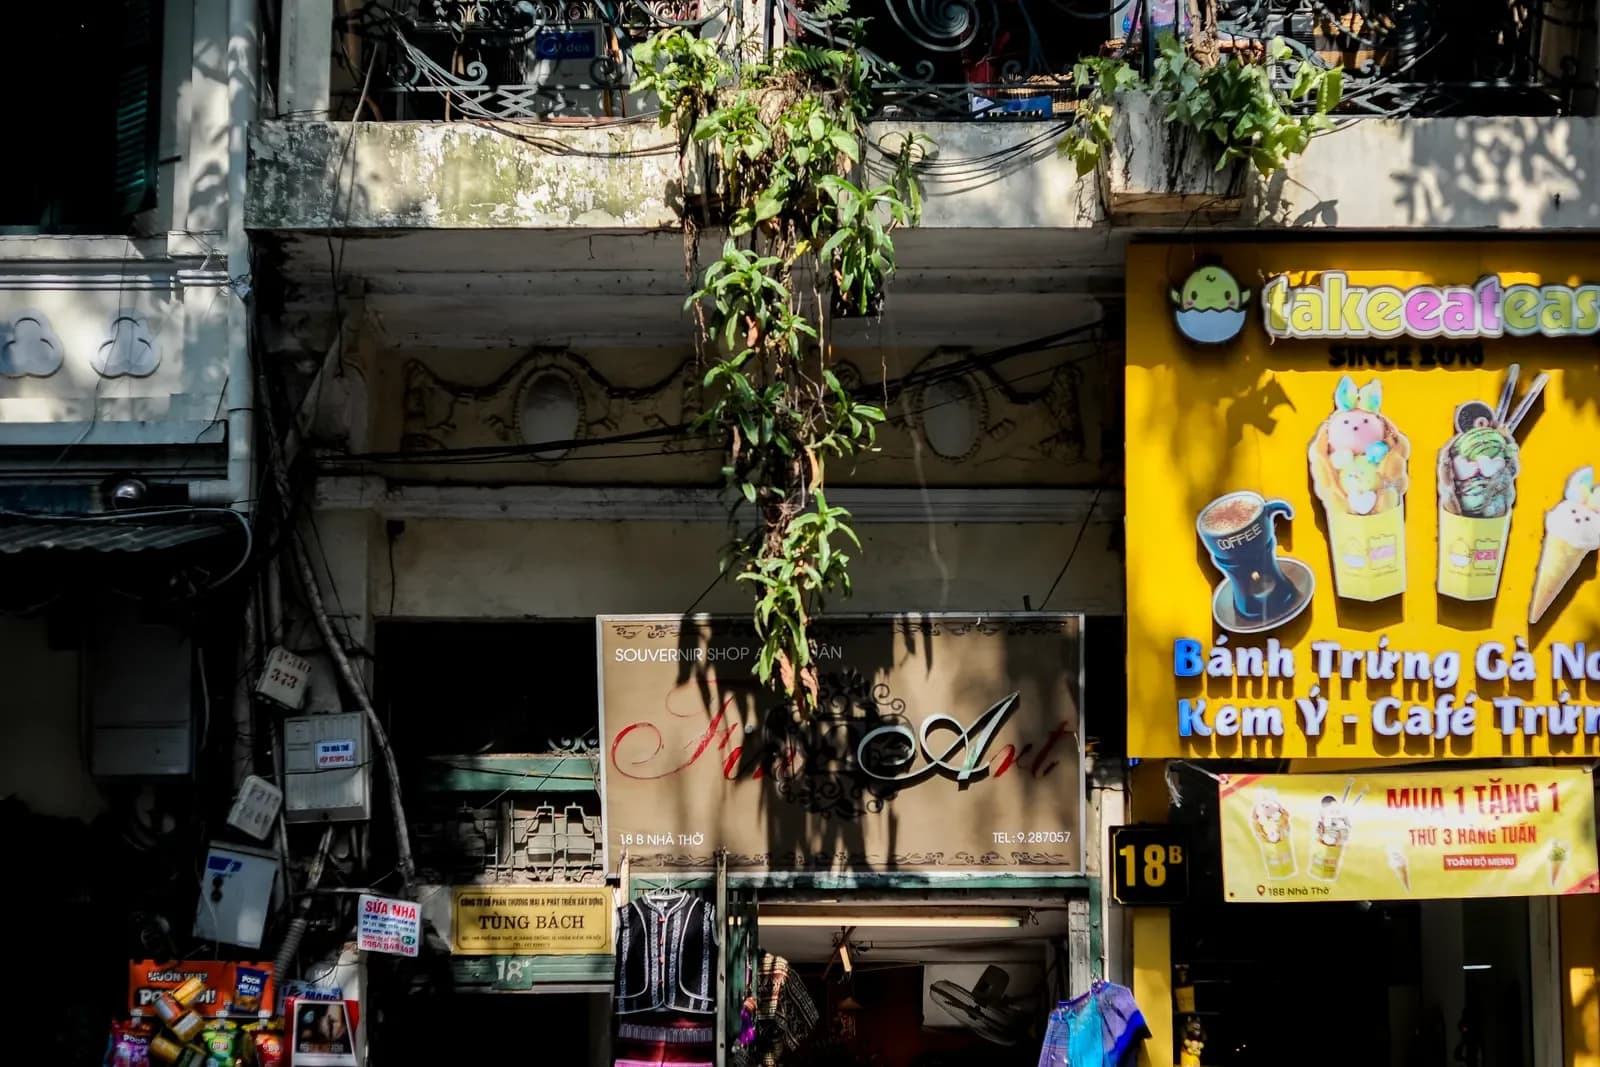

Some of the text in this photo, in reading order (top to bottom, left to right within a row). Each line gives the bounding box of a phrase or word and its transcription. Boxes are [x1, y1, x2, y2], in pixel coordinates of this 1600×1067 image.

[1329, 346, 1412, 367] SINCE
[1216, 523, 1262, 550] COFFEE
[615, 648, 703, 662] SOUVERNIR
[707, 647, 749, 661] SHOP
[1174, 634, 1294, 678] Bánh
[1312, 635, 1460, 688] Trứng
[1475, 636, 1536, 680] Gà
[1178, 699, 1283, 737] Kem
[1296, 685, 1328, 736] Ý
[1372, 691, 1476, 739] Café
[1386, 778, 1560, 820] MUA 1 TẶNG 1
[620, 831, 705, 845] 18 B NHÀ THỜ
[1443, 828, 1453, 845] 3
[1119, 844, 1183, 887] 18B
[1488, 858, 1515, 866] MENU
[1287, 887, 1308, 896] Nhà
[479, 912, 585, 929] TÙNG BÁCH
